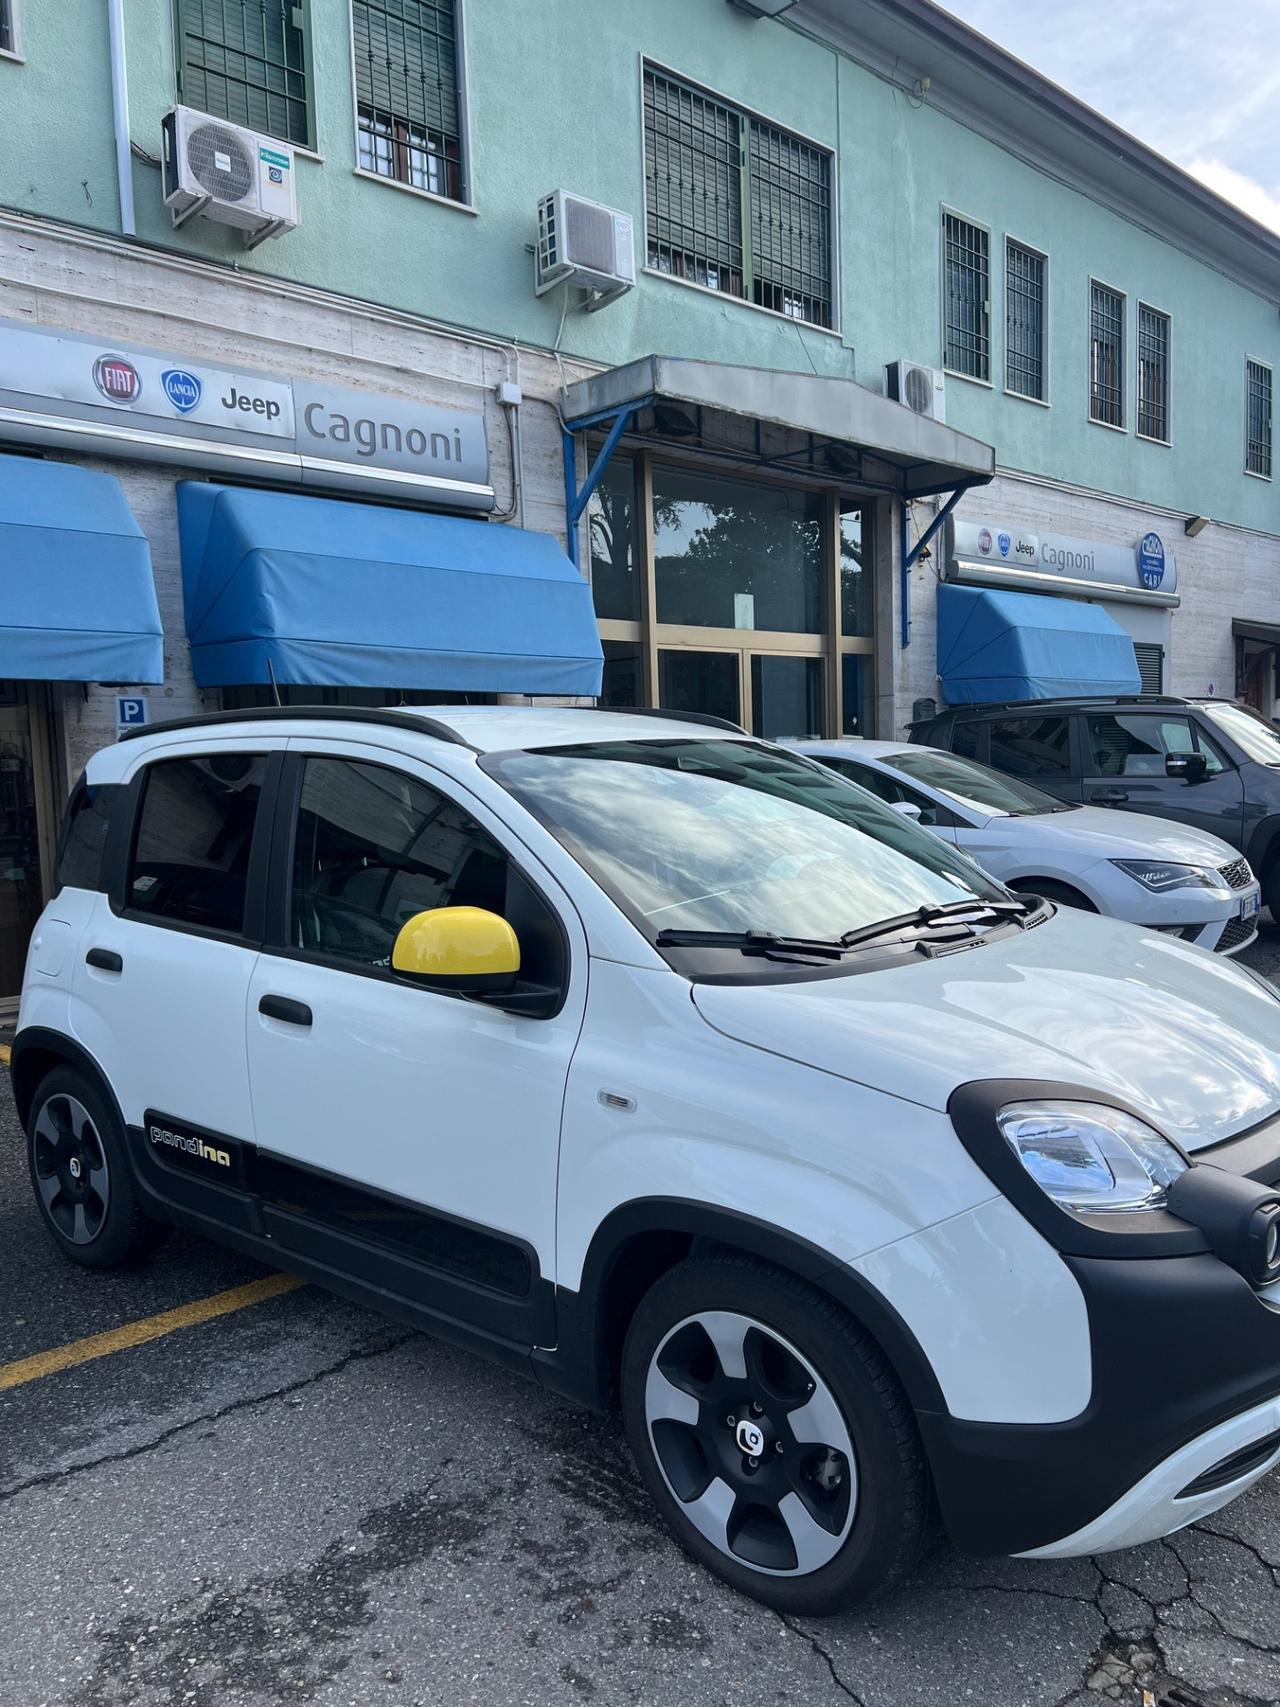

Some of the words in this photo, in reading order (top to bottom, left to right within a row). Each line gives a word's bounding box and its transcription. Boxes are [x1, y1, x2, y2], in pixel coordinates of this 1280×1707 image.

[104, 367, 133, 393] FIAT
[169, 382, 196, 398] LANCIA
[221, 387, 281, 421] Jeep
[304, 402, 462, 462] Cagnoni
[1015, 540, 1035, 557] Jeep
[1041, 543, 1095, 571] Cagnoni
[124, 701, 139, 721] P
[150, 1126, 231, 1167] pandina
